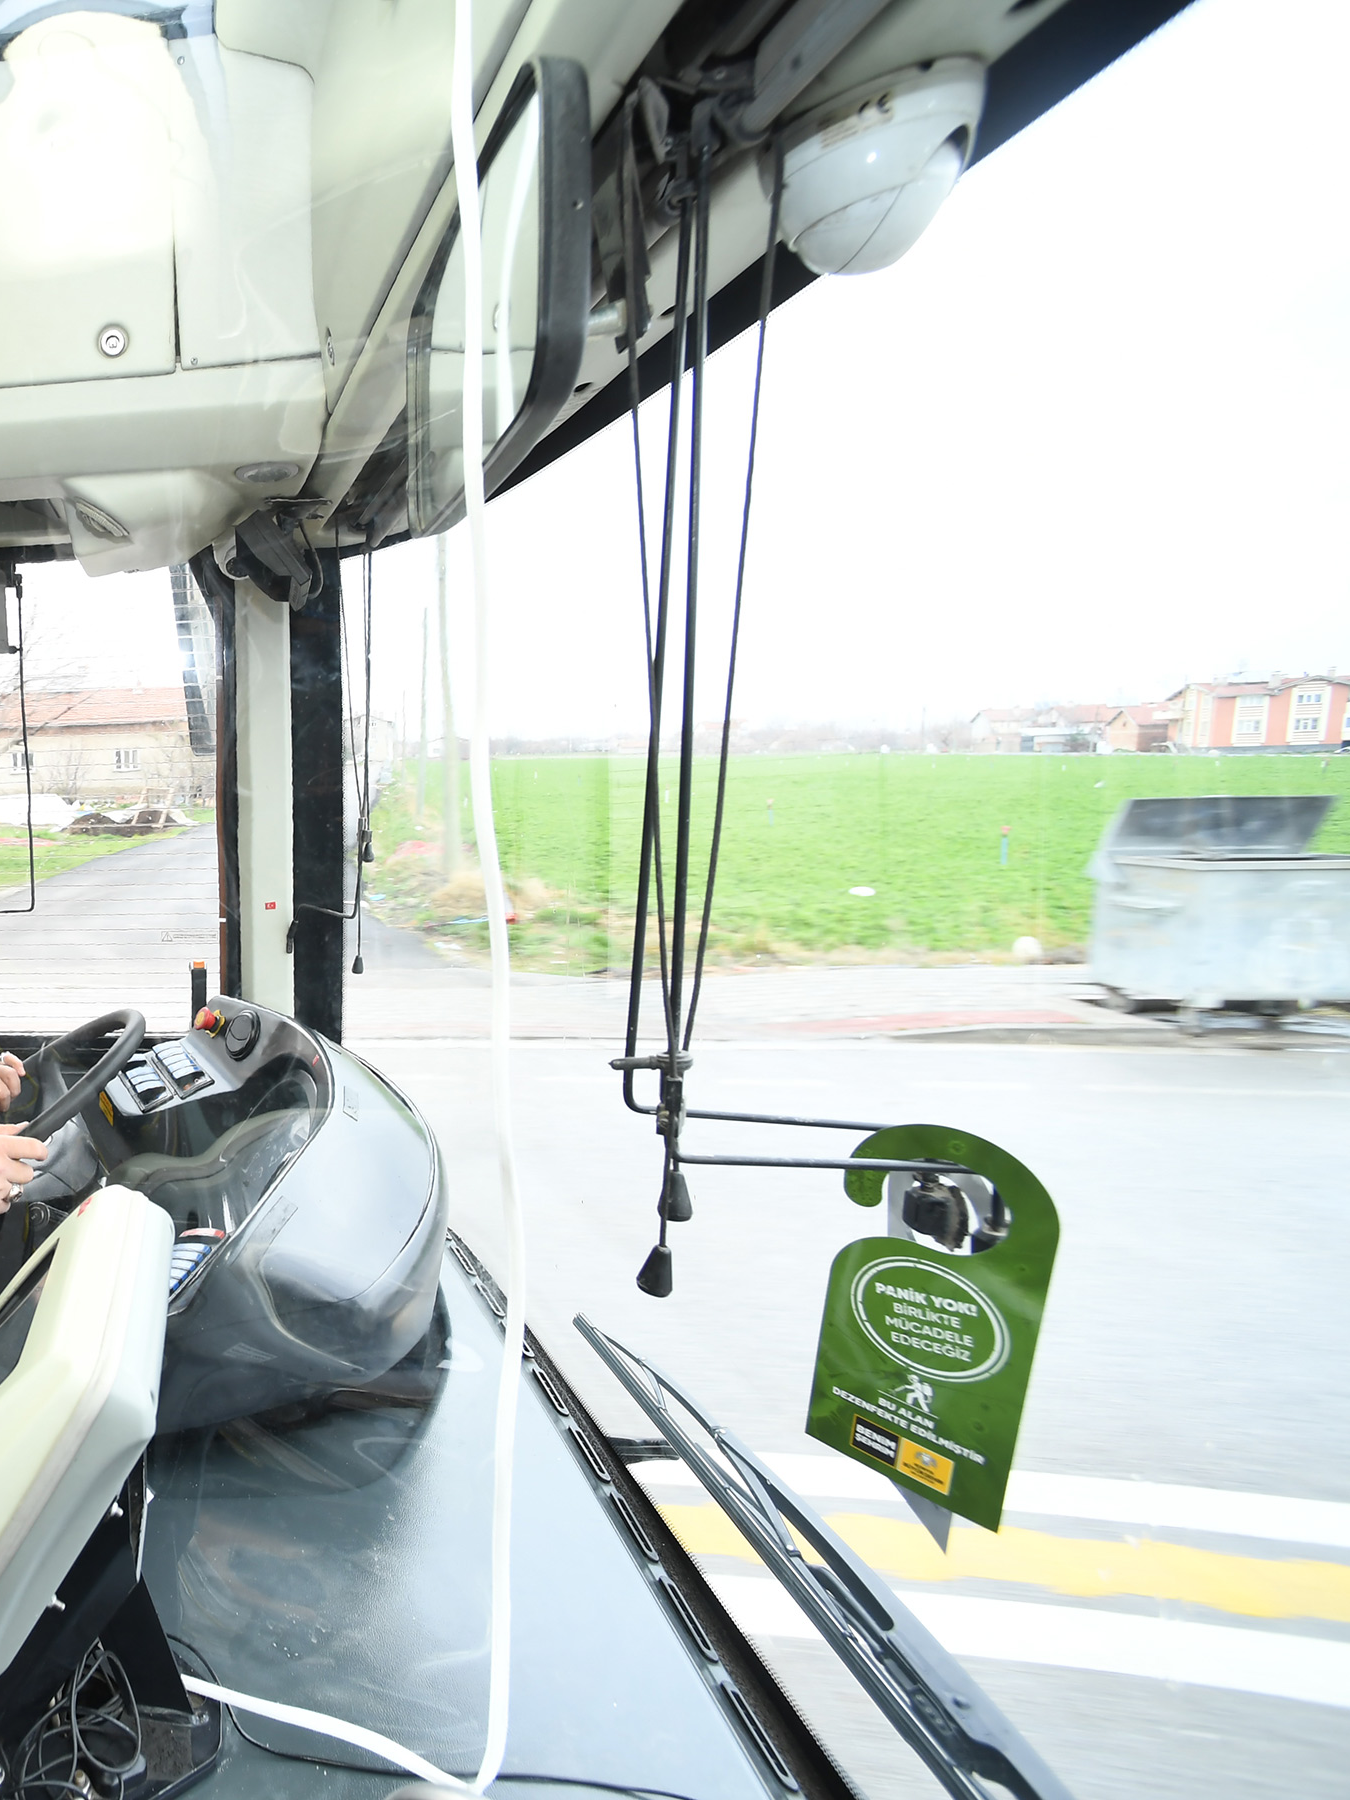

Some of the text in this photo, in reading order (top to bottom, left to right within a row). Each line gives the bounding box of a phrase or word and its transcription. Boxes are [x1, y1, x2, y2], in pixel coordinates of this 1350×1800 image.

[874, 1282, 978, 1317] PANİK YOK!
[892, 1302, 962, 1329] BİRLİKTE
[884, 1315, 974, 1348] MÜCADELE
[890, 1331, 972, 1362] EDECEĞİZ
[832, 1386, 986, 1466] DEZENFEKTE EDİLMİŞTİR
[877, 1397, 936, 1430] BU ALAN
